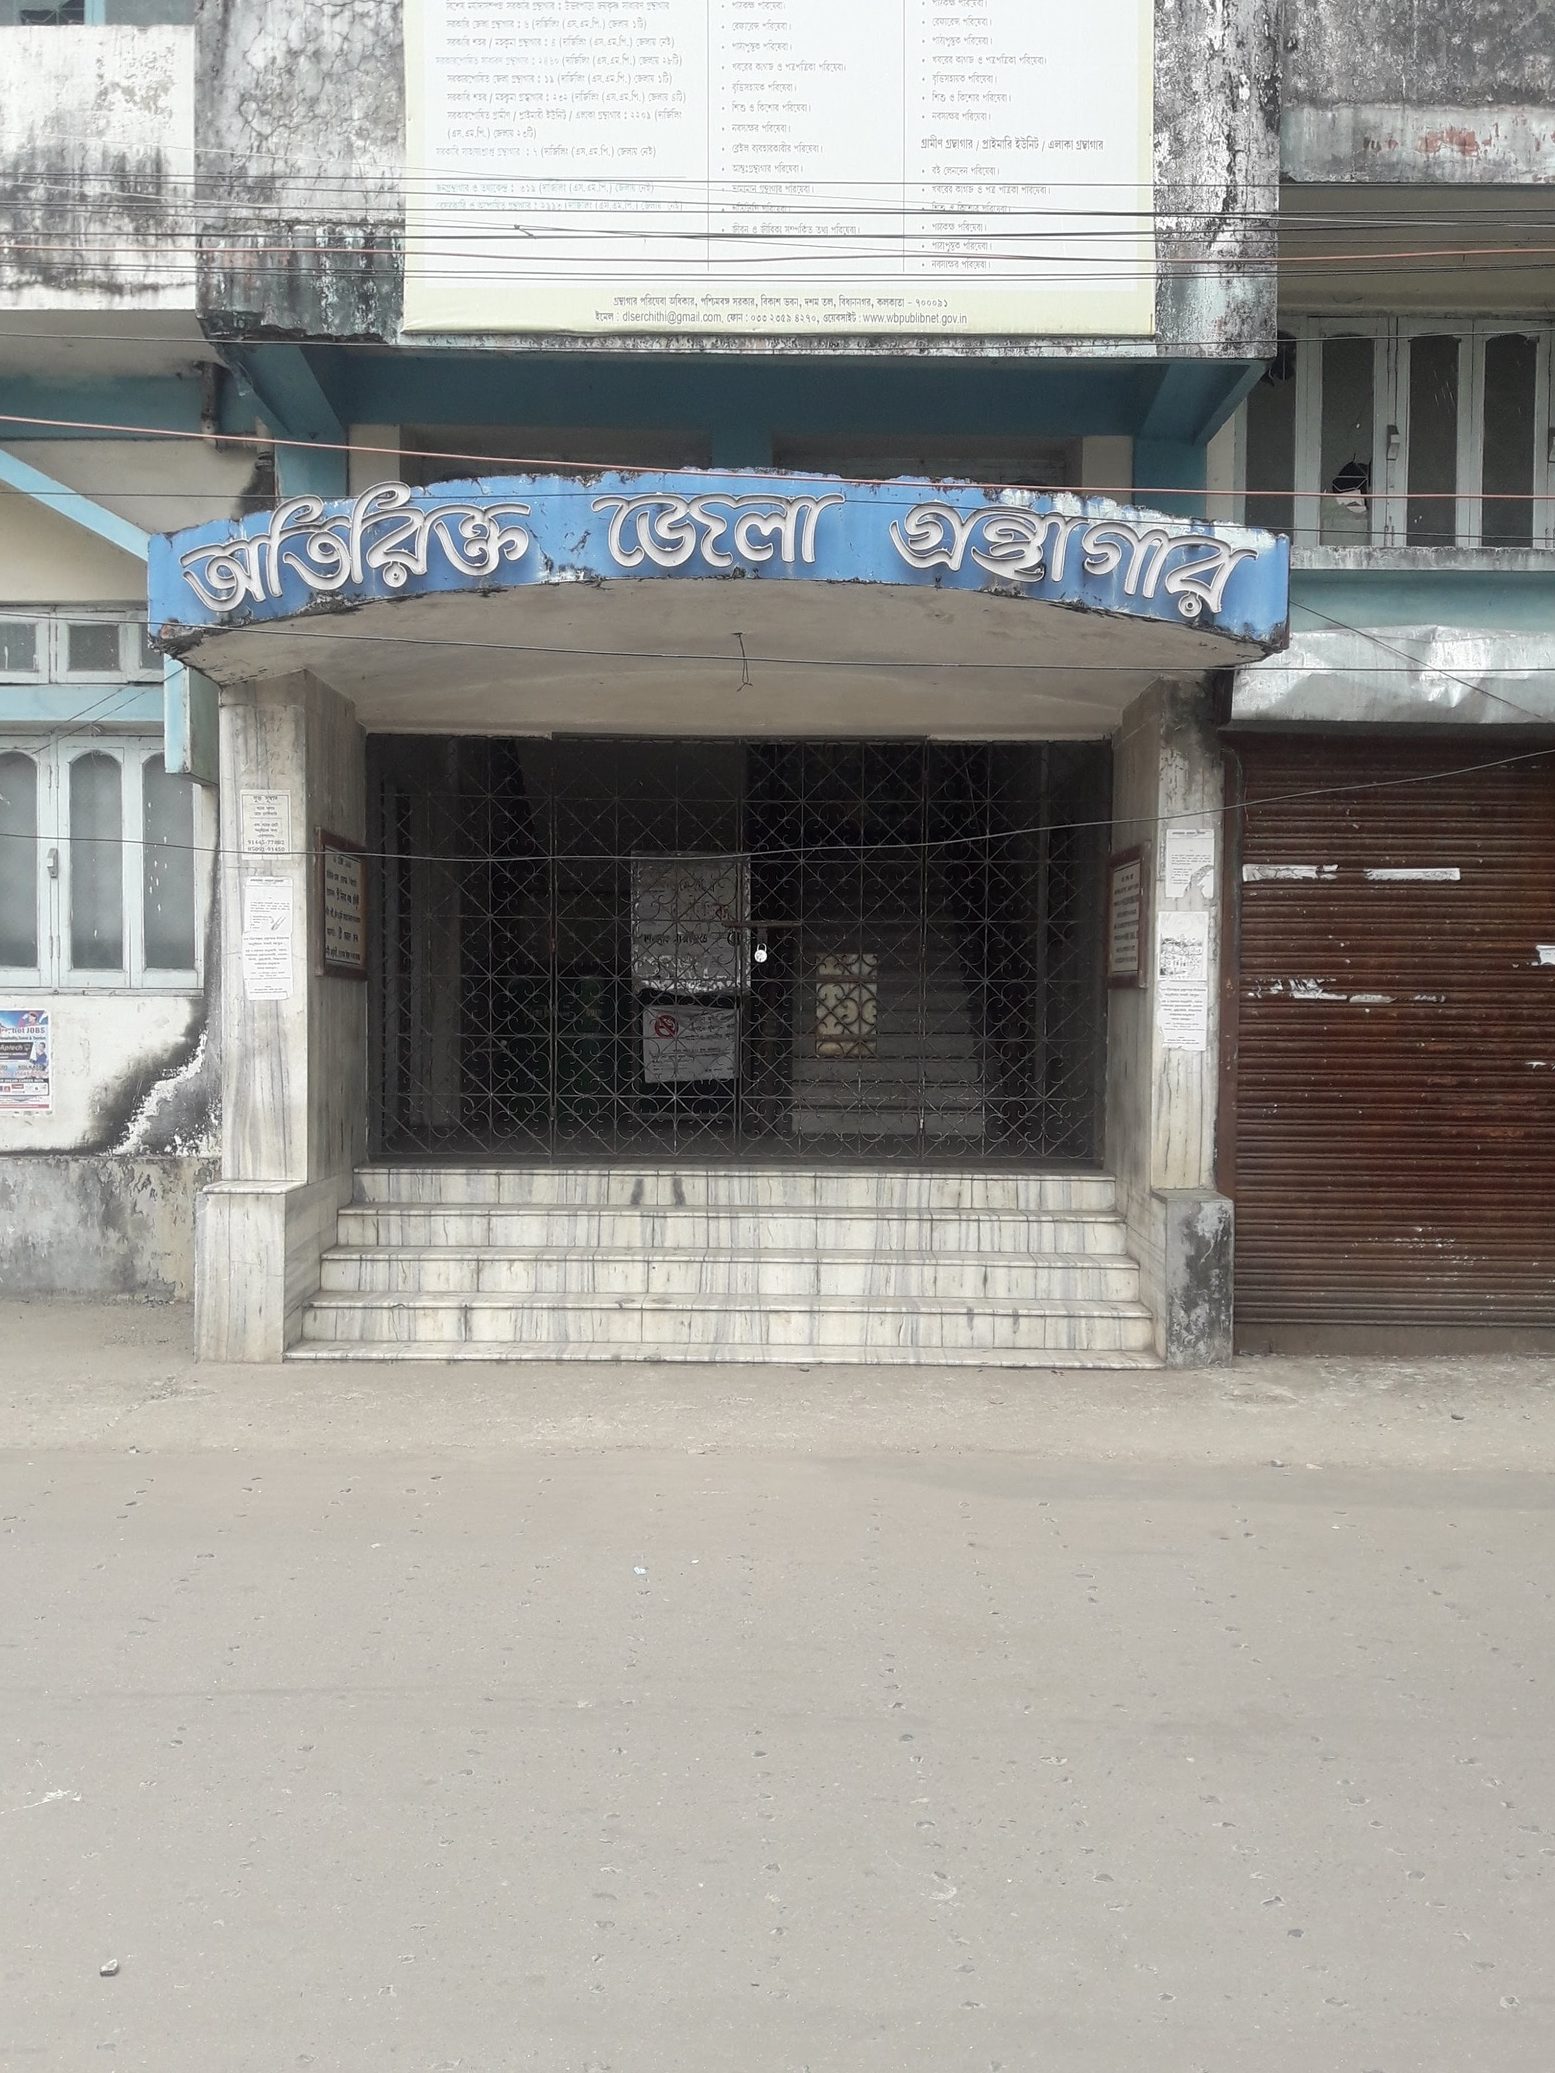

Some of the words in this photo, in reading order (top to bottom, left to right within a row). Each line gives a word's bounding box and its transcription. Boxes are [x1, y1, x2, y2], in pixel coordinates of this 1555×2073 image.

[863, 312, 968, 327] www.wbpublibnet.gov.in
[180, 481, 530, 612] অতিরিক্ত
[592, 492, 845, 568] জেলা
[889, 499, 1260, 618] গ্রন্থাগার
